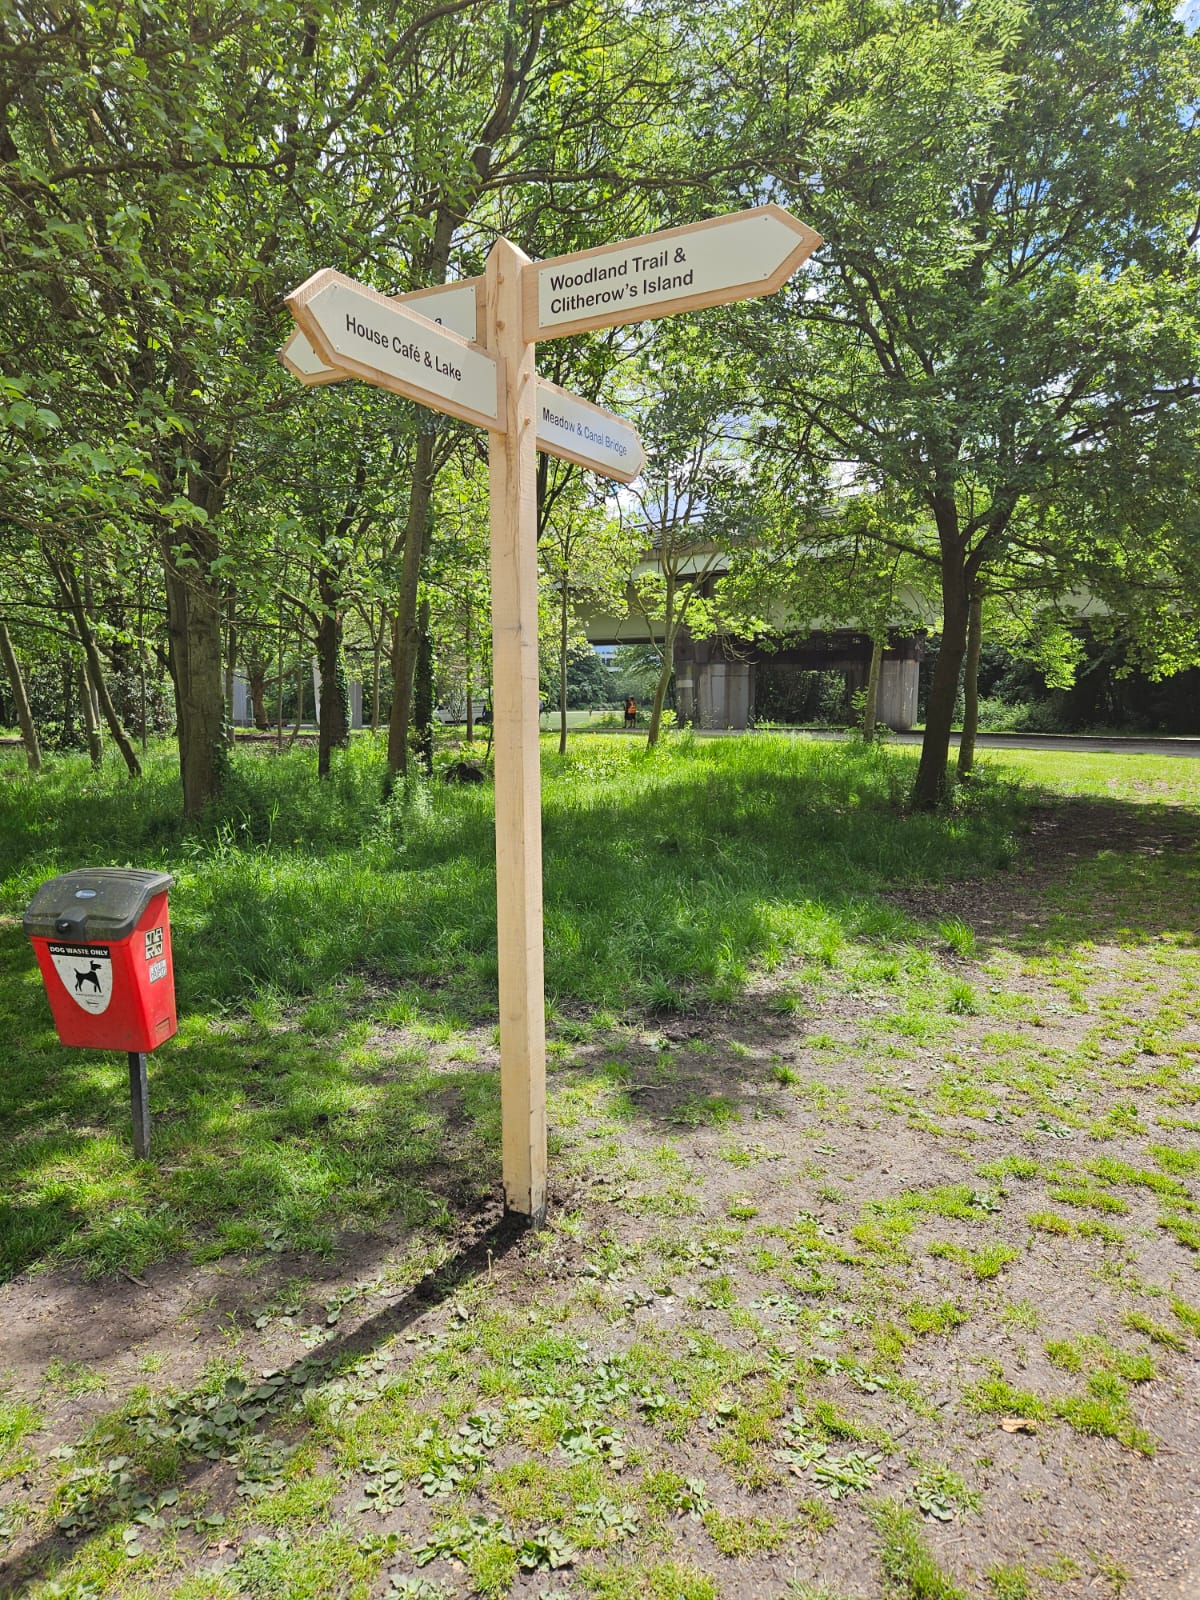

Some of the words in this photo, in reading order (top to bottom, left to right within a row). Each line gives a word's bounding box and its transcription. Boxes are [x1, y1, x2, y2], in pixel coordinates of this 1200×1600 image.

[550, 259, 628, 292] Woodland
[632, 249, 668, 273] Trail
[673, 247, 687, 263] &
[643, 268, 694, 295] Island
[346, 313, 389, 349] House
[392, 336, 421, 363] Café
[423, 351, 433, 369] &
[435, 355, 462, 382] Lake
[542, 406, 576, 433] Meadow
[576, 422, 583, 437] &
[584, 426, 604, 446] Canal
[605, 435, 628, 457] Bridge
[65, 947, 90, 955] WASTE
